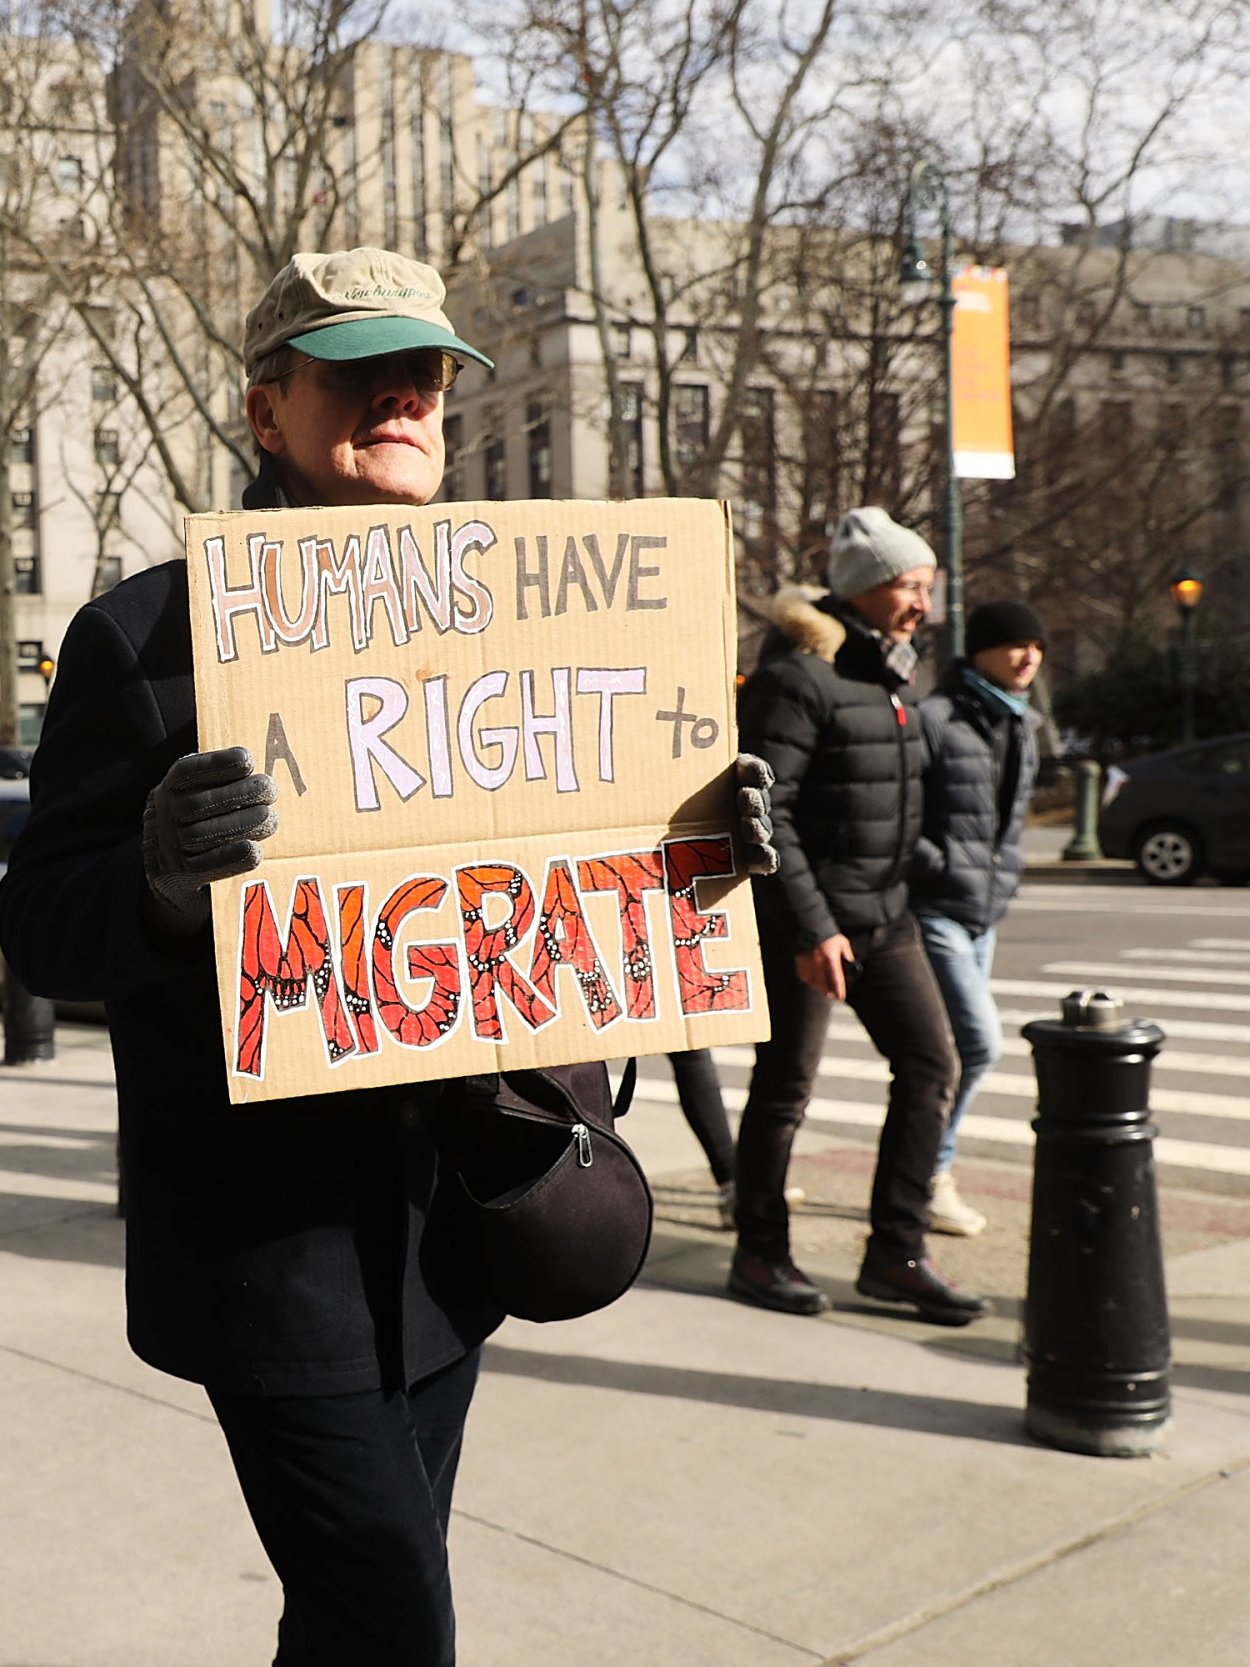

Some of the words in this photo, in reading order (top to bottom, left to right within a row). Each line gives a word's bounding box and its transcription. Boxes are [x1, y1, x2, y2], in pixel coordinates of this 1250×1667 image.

[205, 520, 498, 662] HUMANS
[514, 533, 668, 620] HAVE
[264, 713, 307, 796] A
[344, 666, 647, 812] RIGHT
[656, 687, 719, 759] to
[233, 835, 751, 1081] MIGRATE
